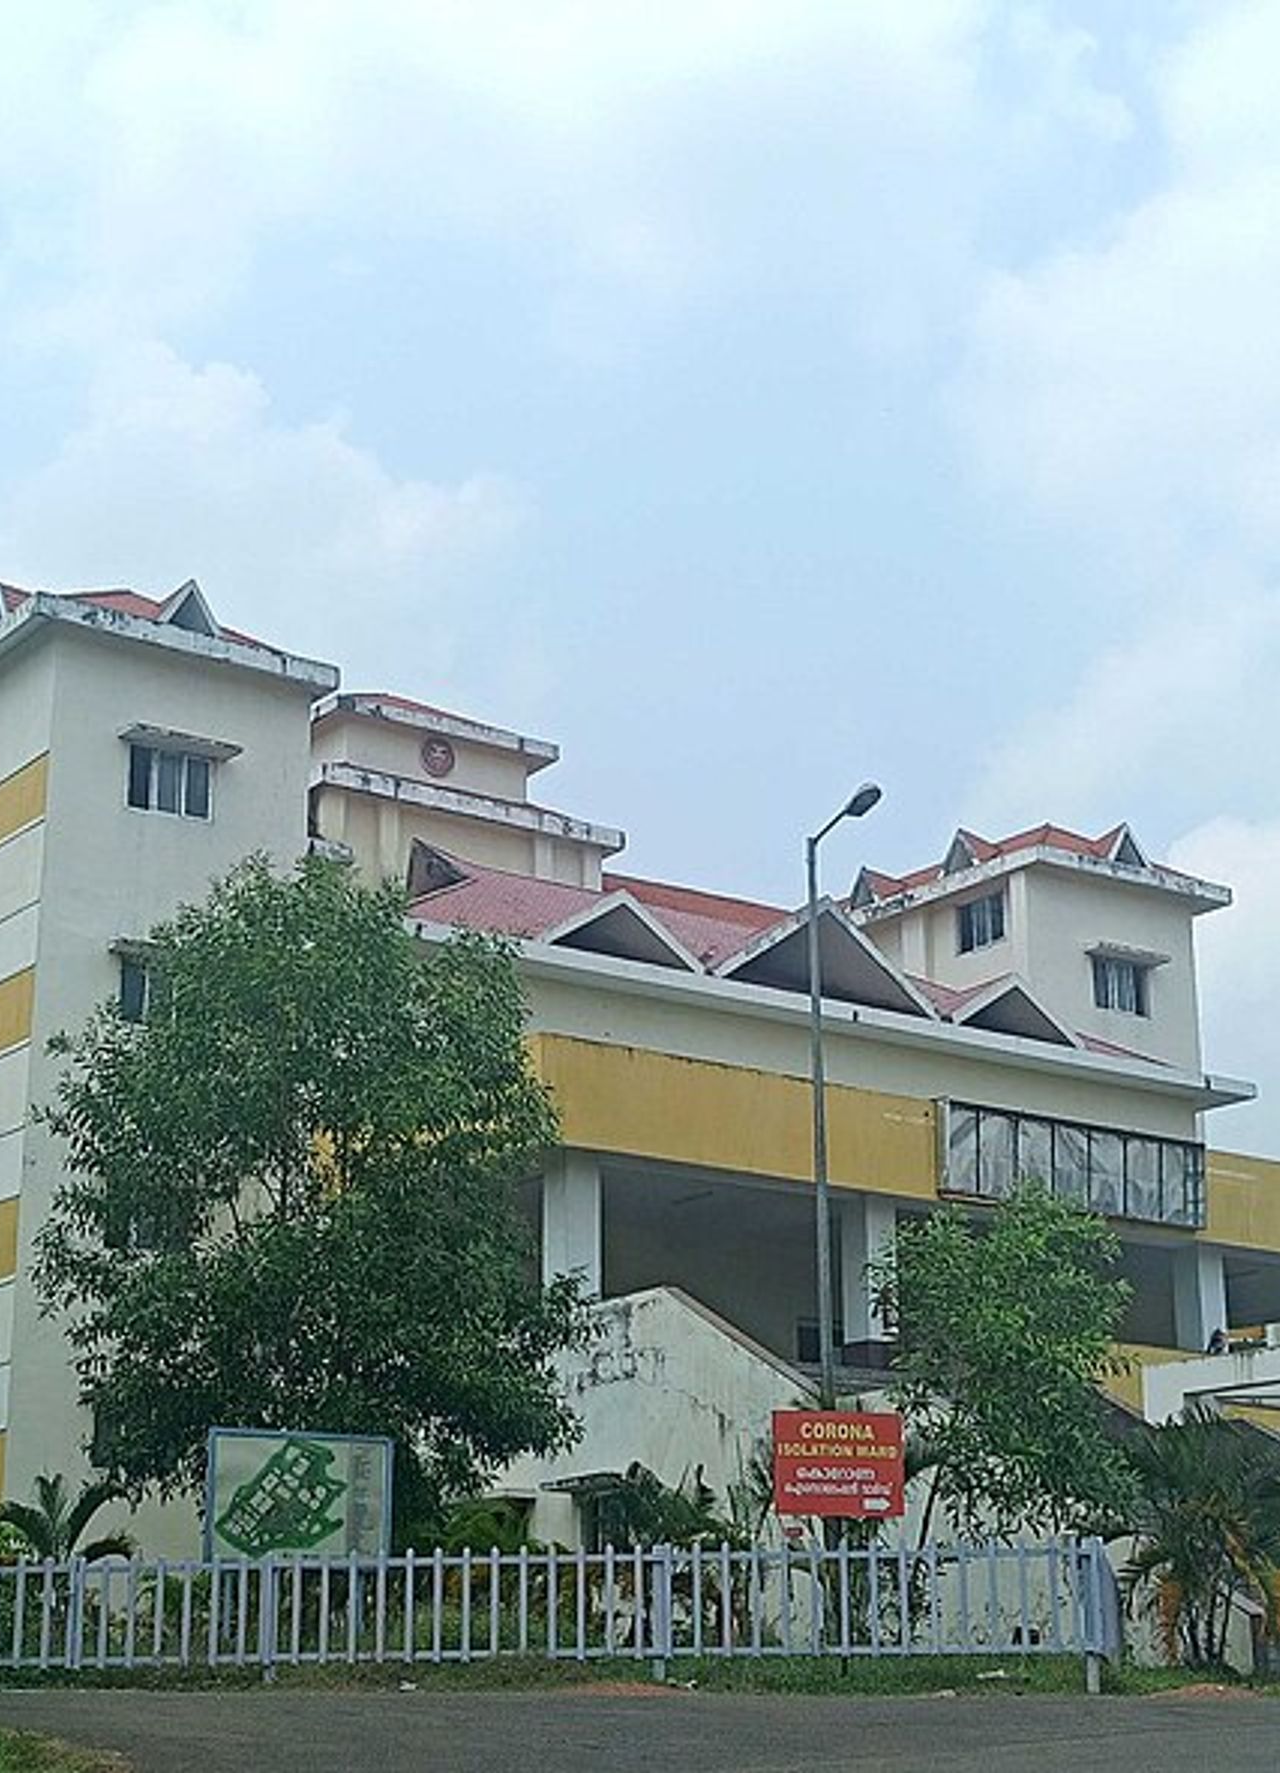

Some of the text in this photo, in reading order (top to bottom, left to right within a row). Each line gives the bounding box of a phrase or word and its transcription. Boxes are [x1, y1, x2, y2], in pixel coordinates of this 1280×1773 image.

[800, 1421, 875, 1440] CORONA
[778, 1443, 897, 1459] ISOLATION WARD
